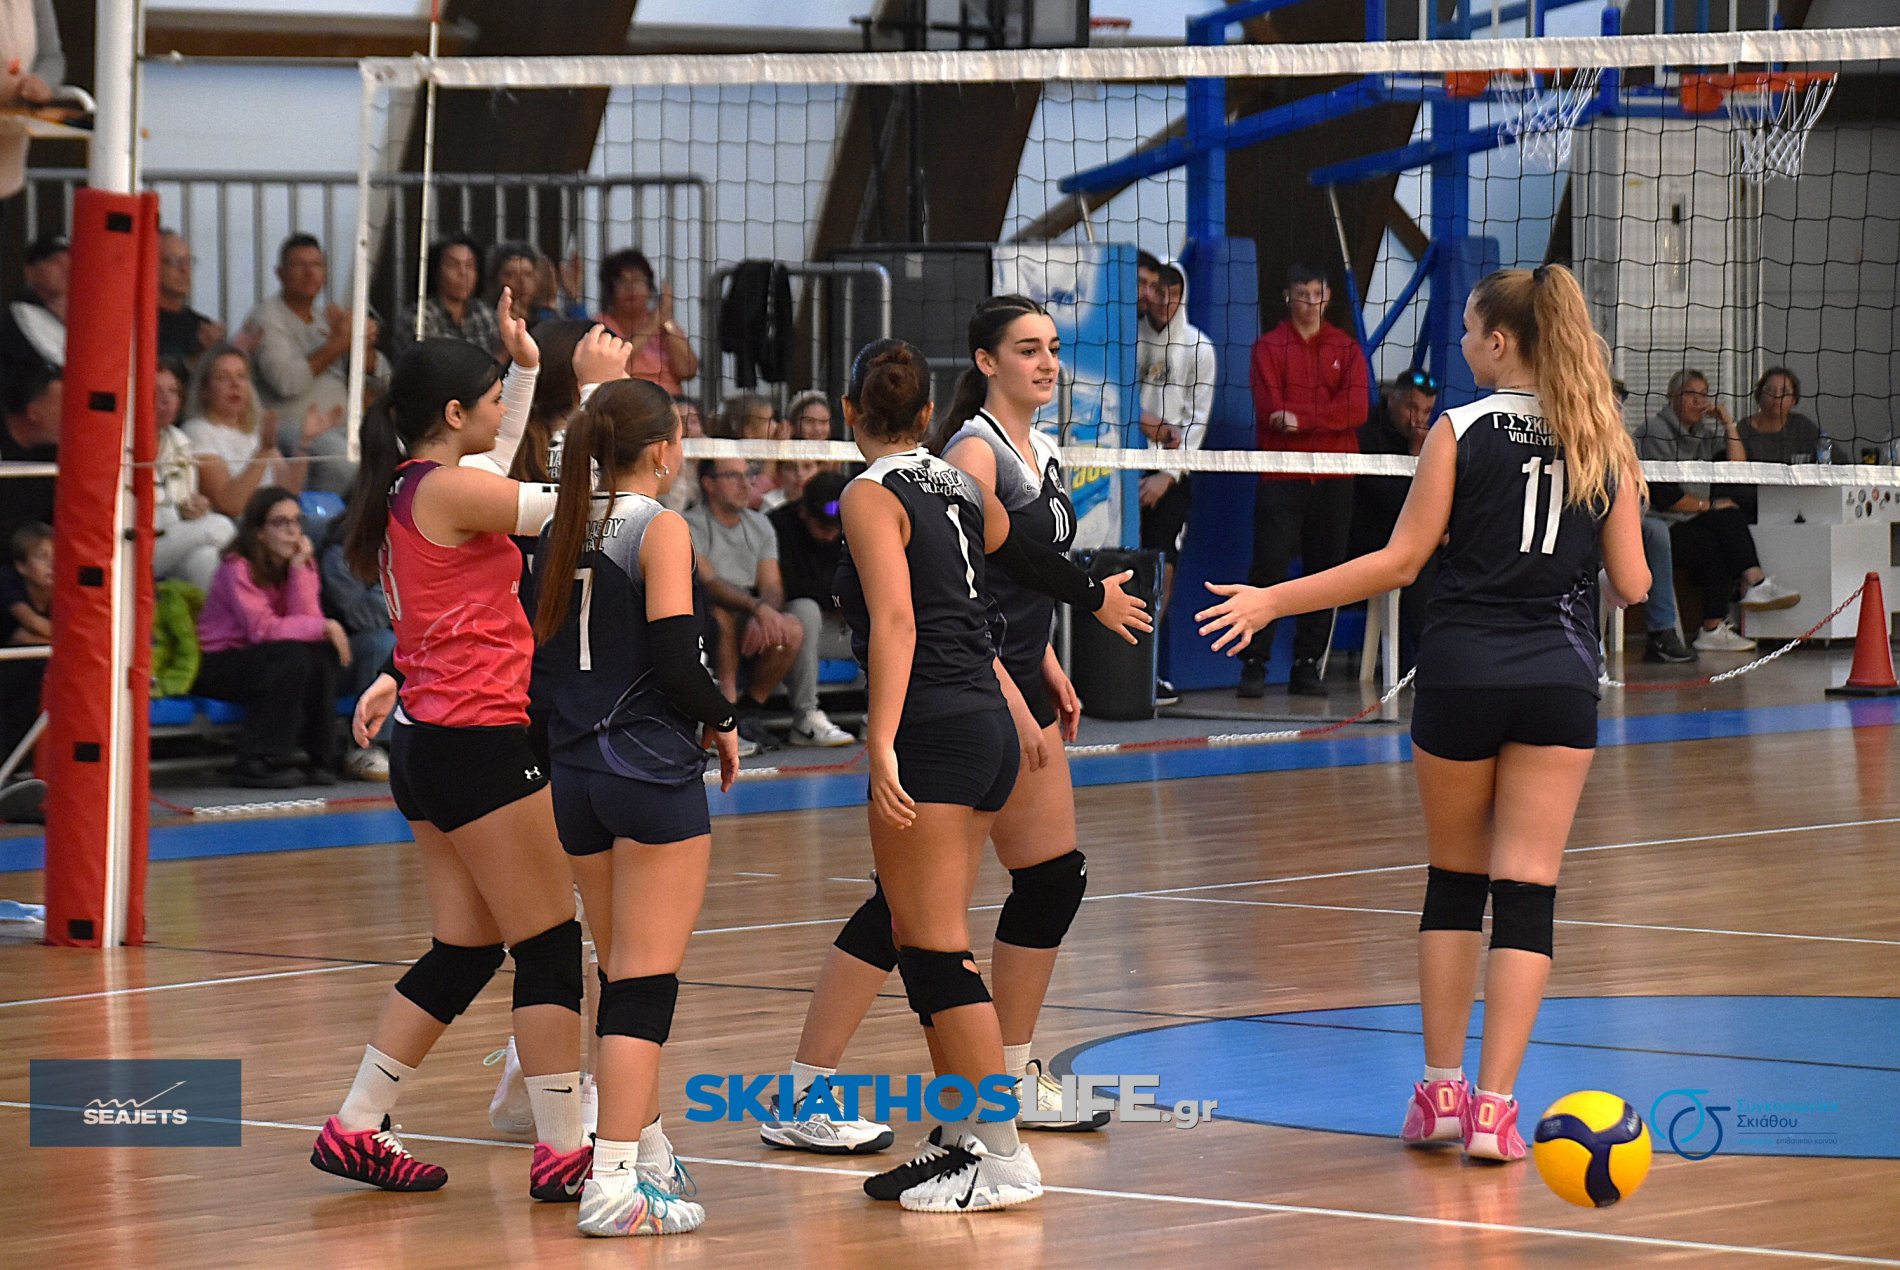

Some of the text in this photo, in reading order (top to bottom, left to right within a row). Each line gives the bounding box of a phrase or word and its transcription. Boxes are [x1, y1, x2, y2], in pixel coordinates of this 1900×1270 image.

[945, 503, 978, 599] 1
[1049, 497, 1070, 543] 10
[1520, 456, 1564, 554] 11
[573, 567, 593, 671] 7
